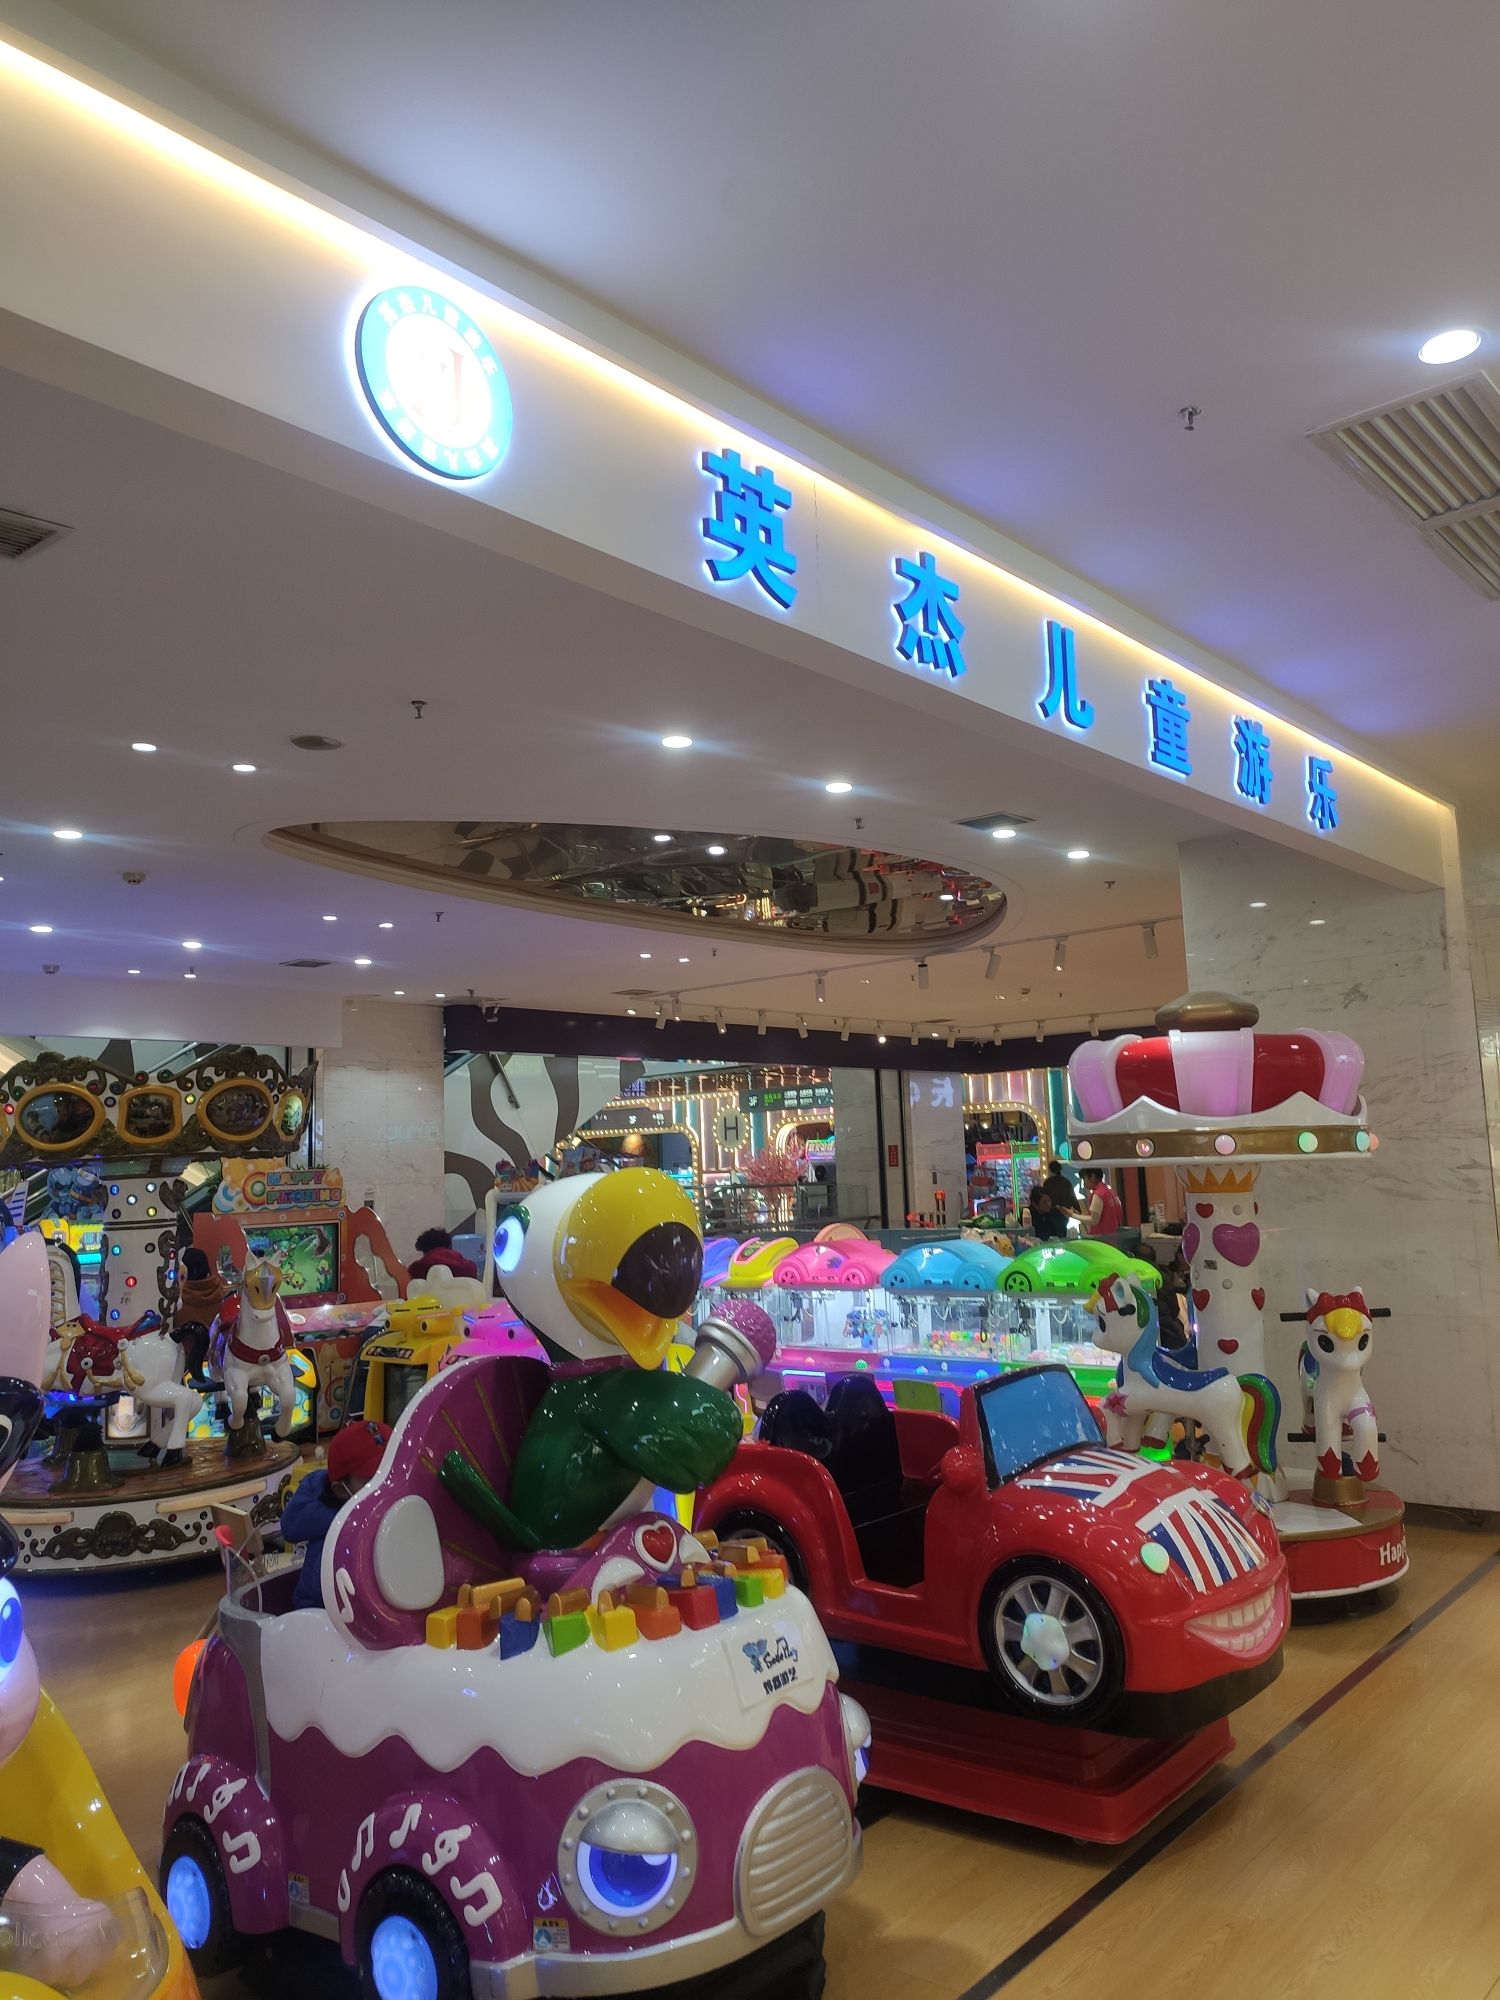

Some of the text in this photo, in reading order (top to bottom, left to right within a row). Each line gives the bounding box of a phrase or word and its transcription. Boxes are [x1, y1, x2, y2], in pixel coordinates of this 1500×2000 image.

[700, 447, 1340, 831] 英杰儿童游乐
[266, 1170, 326, 1187] HAPPY
[265, 1188, 343, 1205] PITCHING
